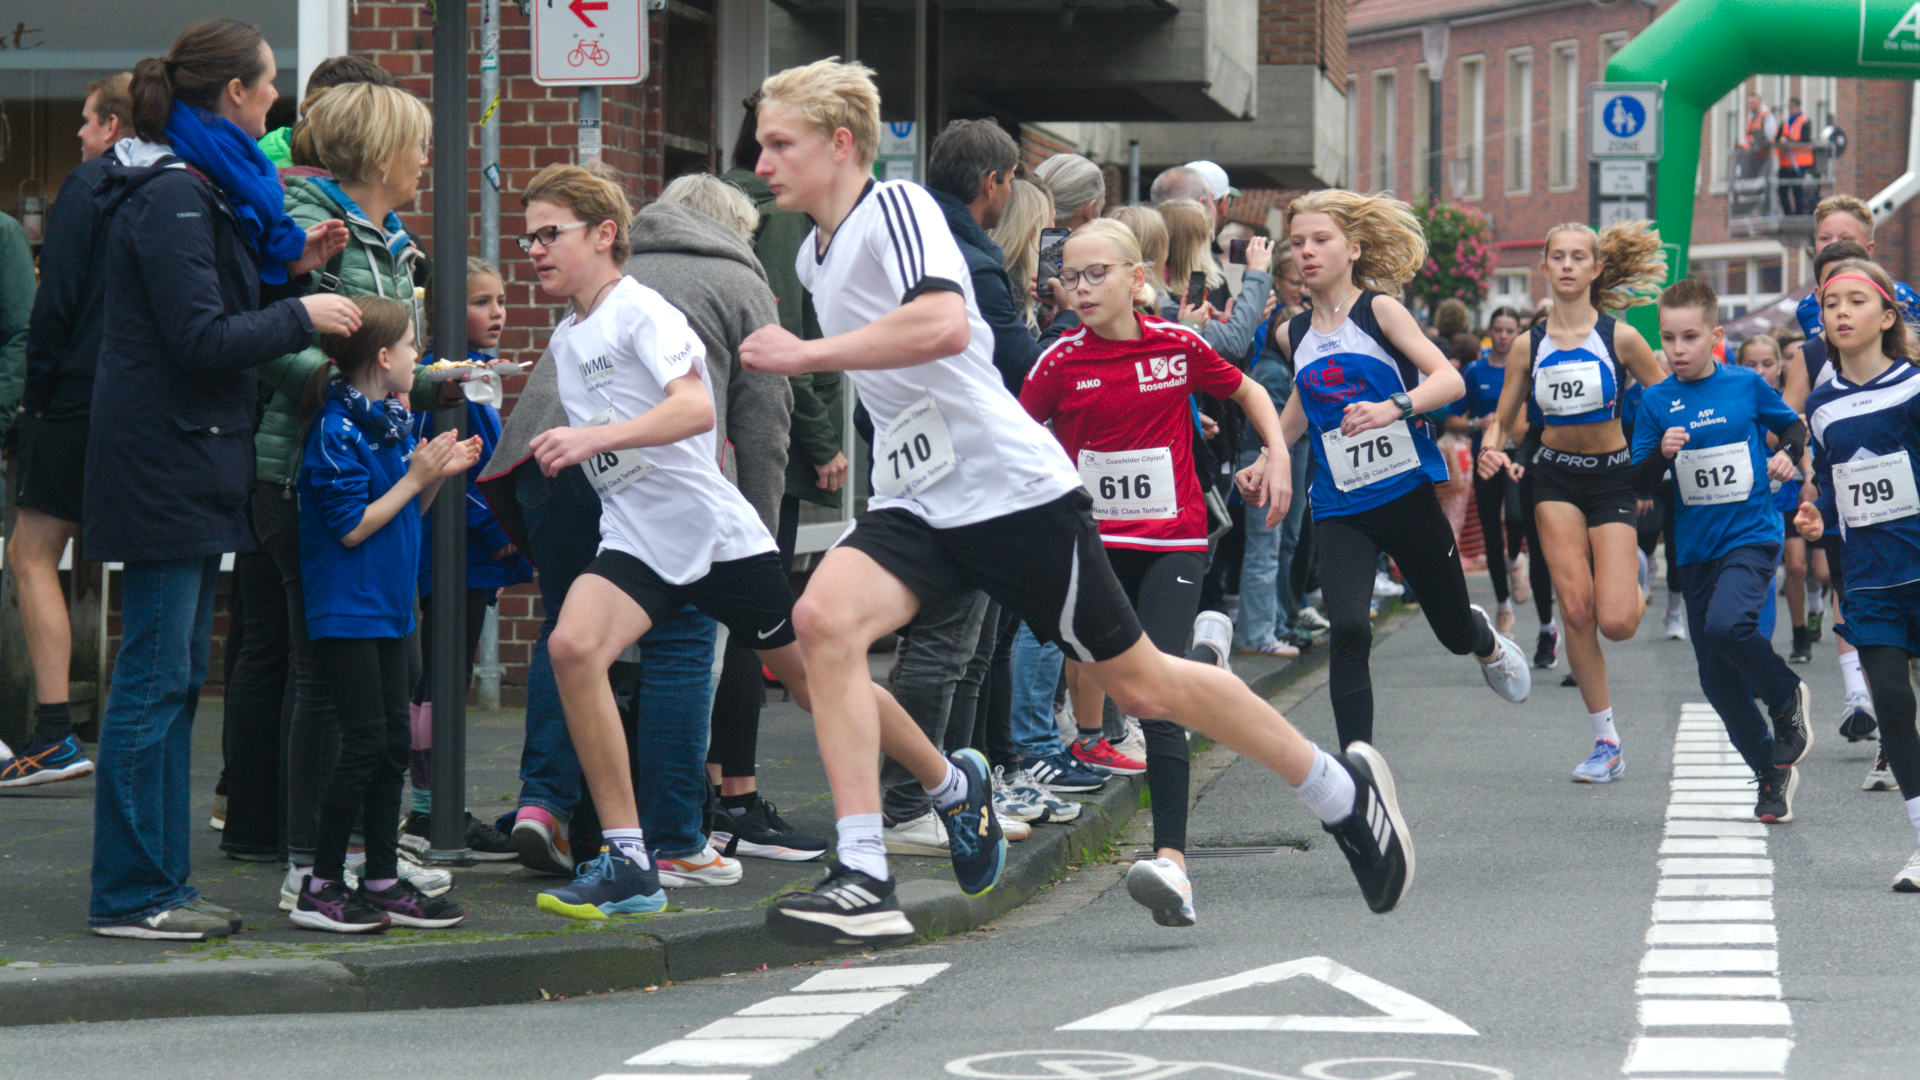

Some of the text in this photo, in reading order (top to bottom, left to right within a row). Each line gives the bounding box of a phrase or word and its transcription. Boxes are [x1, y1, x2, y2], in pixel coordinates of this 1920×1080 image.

[1608, 140, 1640, 152] ZONE
[1076, 378, 1101, 391] JAKO
[1139, 376, 1188, 393] Rosendahl
[1302, 369, 1320, 389] LG
[1548, 379, 1585, 401] 792
[1698, 408, 1714, 418] ASV
[1690, 416, 1727, 429] Duisburg
[887, 432, 931, 480] 710
[1105, 457, 1140, 465] Coesfelder
[1141, 454, 1165, 463] Citylauf
[1345, 435, 1393, 469] 776
[1556, 453, 1599, 468] PRO
[1850, 458, 1903, 474] Coesfelder Citylauf
[620, 465, 642, 480] Terbeck
[1343, 458, 1412, 487] Allianz Claus Terbeck
[1694, 464, 1737, 489] 612
[1099, 474, 1151, 500] 616
[1848, 478, 1894, 507] 799
[1091, 506, 1168, 515] llianz Claus Terbeck
[1870, 510, 1888, 519] Claus
[1888, 504, 1913, 514] Terbeck
